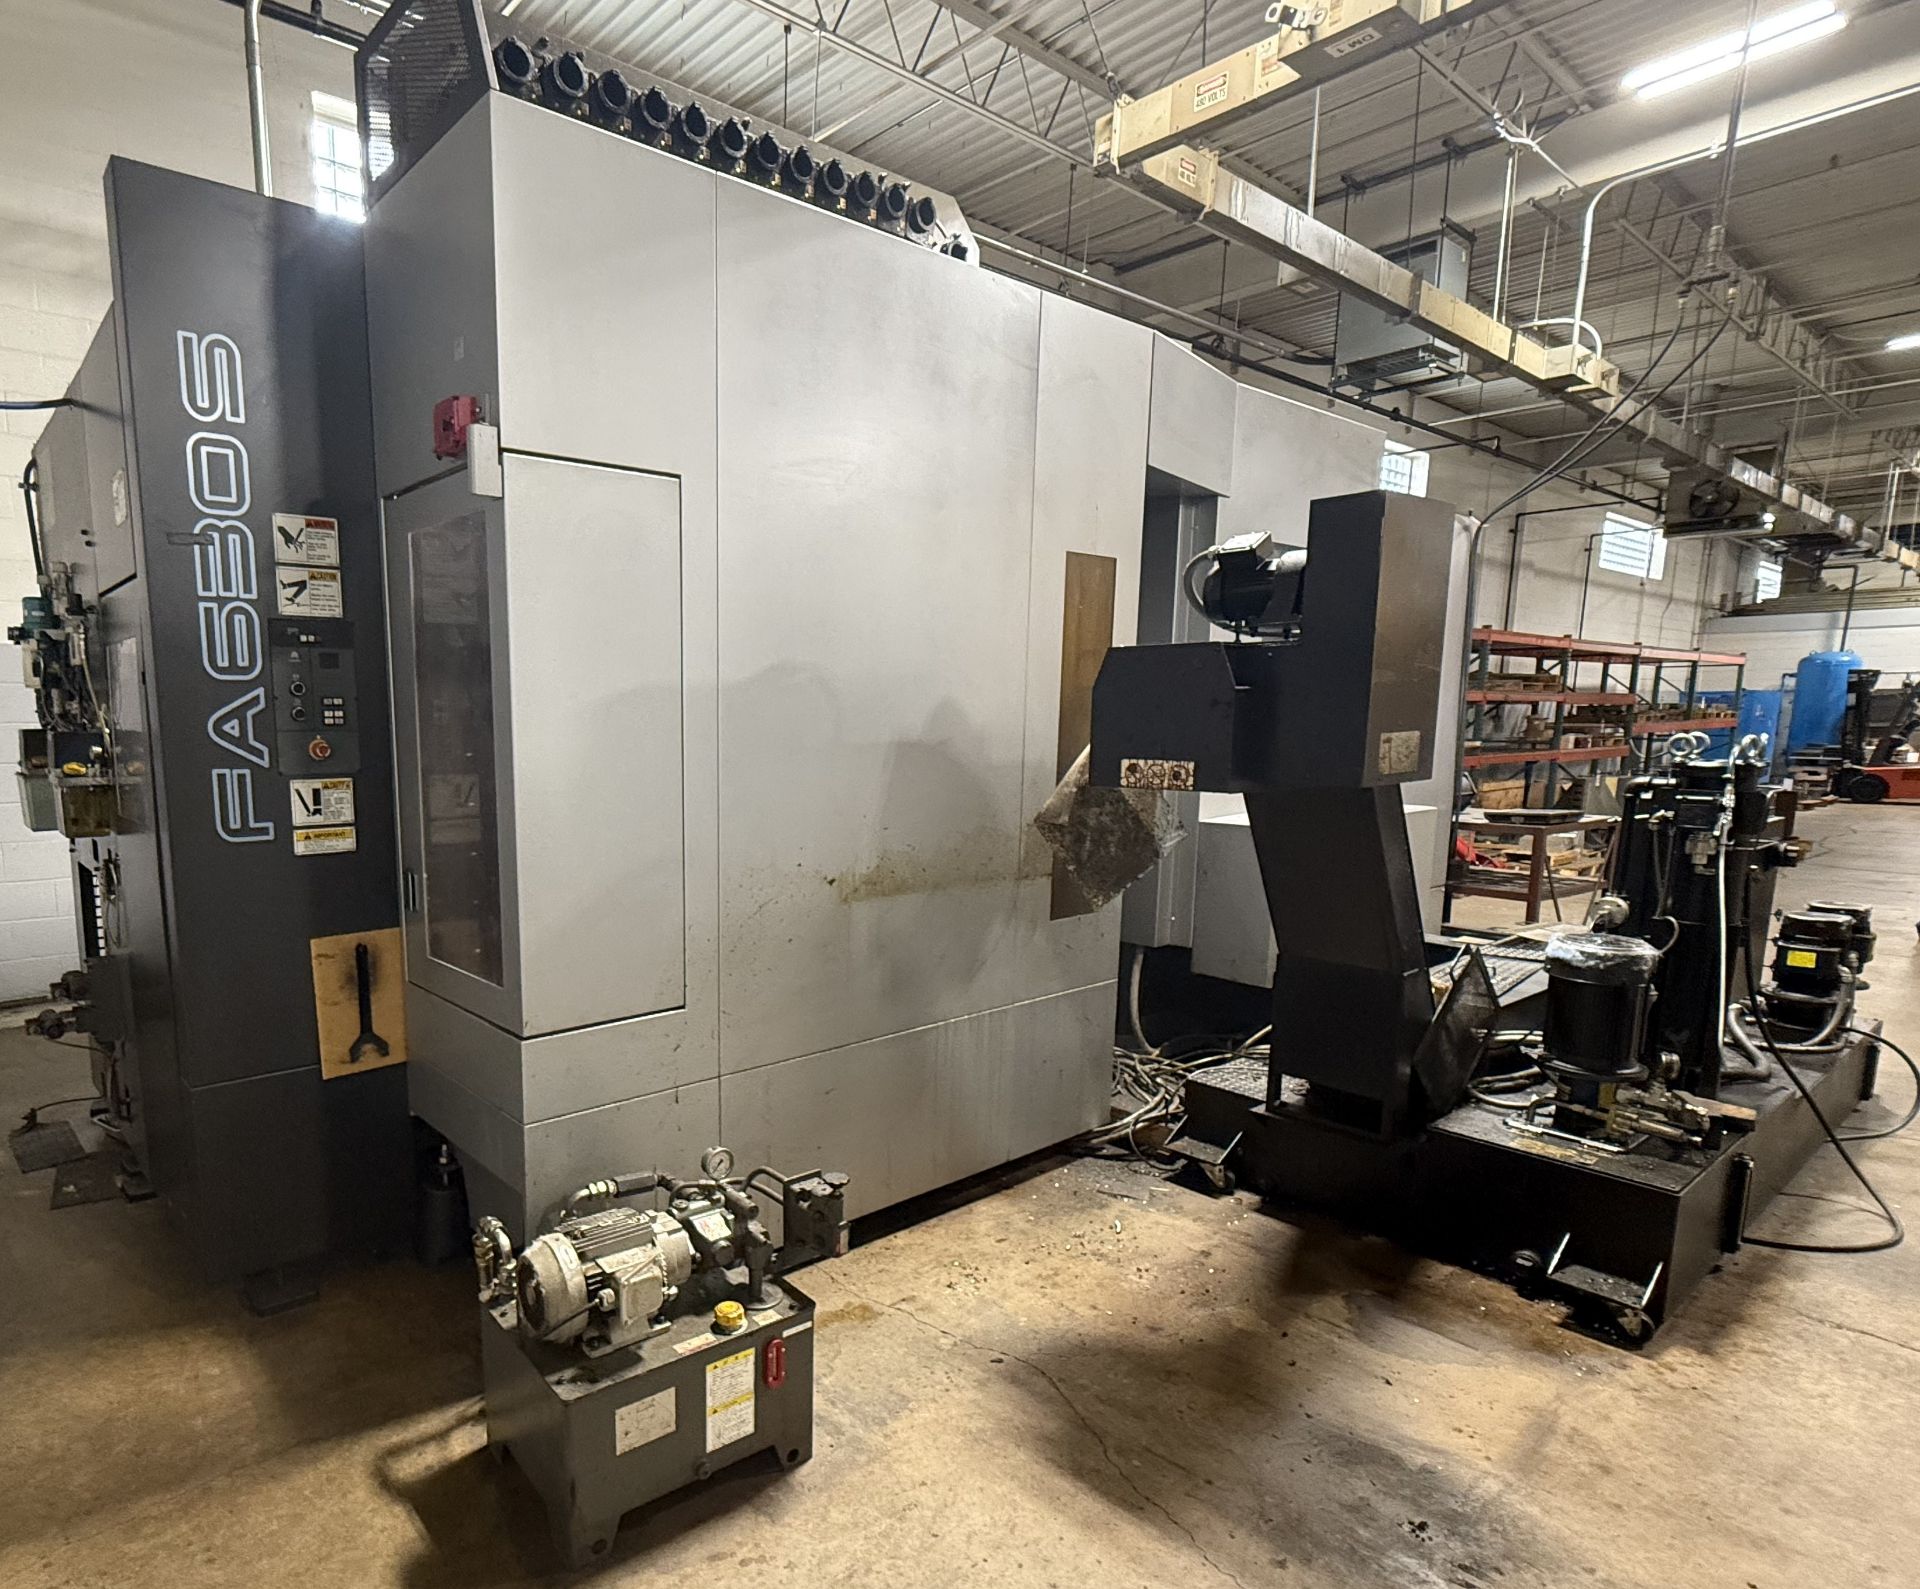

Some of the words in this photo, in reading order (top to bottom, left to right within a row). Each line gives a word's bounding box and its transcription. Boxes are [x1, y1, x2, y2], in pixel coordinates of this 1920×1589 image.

[1348, 33, 1375, 48] DM
[1208, 88, 1226, 103] VOLTS
[177, 330, 275, 842] FA630S
